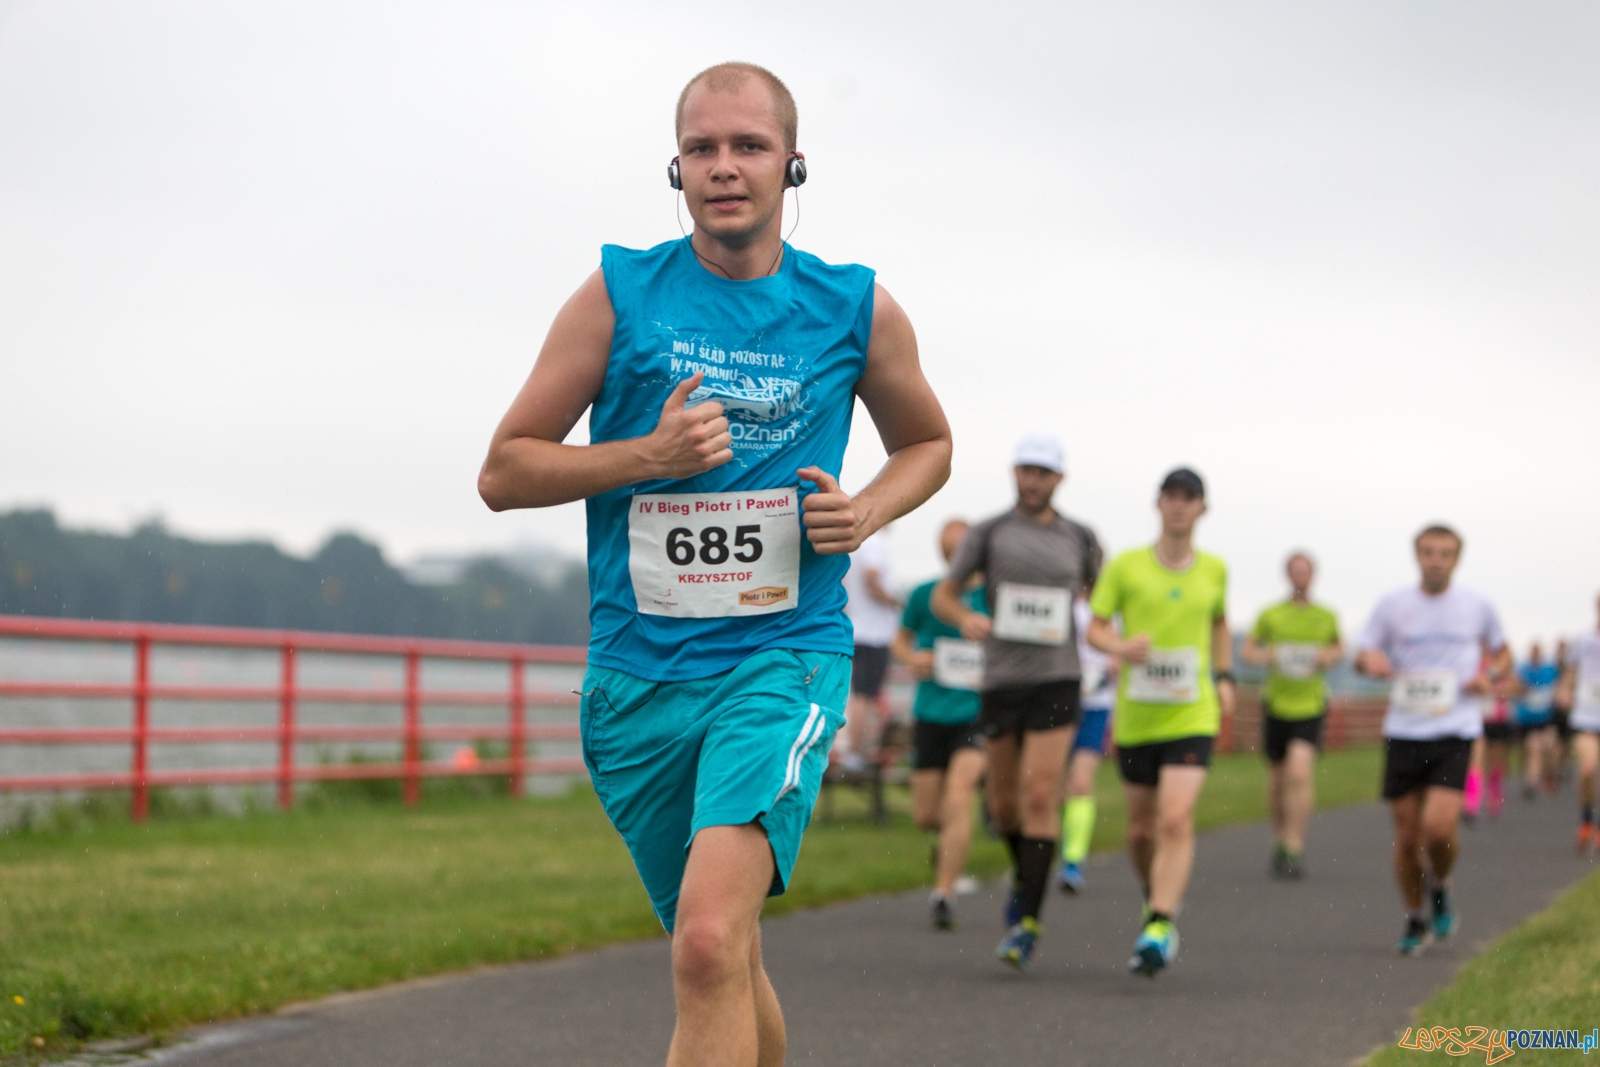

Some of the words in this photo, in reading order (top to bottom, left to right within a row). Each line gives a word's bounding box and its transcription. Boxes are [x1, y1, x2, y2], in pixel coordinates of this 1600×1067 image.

[729, 350, 786, 369] POZOSTAŁ
[670, 358, 683, 372] W
[684, 360, 739, 382] POZNANIU
[639, 502, 653, 514] IV
[657, 502, 690, 516] Bieg
[695, 500, 732, 513] Piotr
[736, 499, 741, 511] i
[746, 495, 789, 511] Paweł
[666, 524, 763, 566] 685
[678, 571, 753, 583] KRZYSZTOF
[740, 593, 760, 602] Piotr
